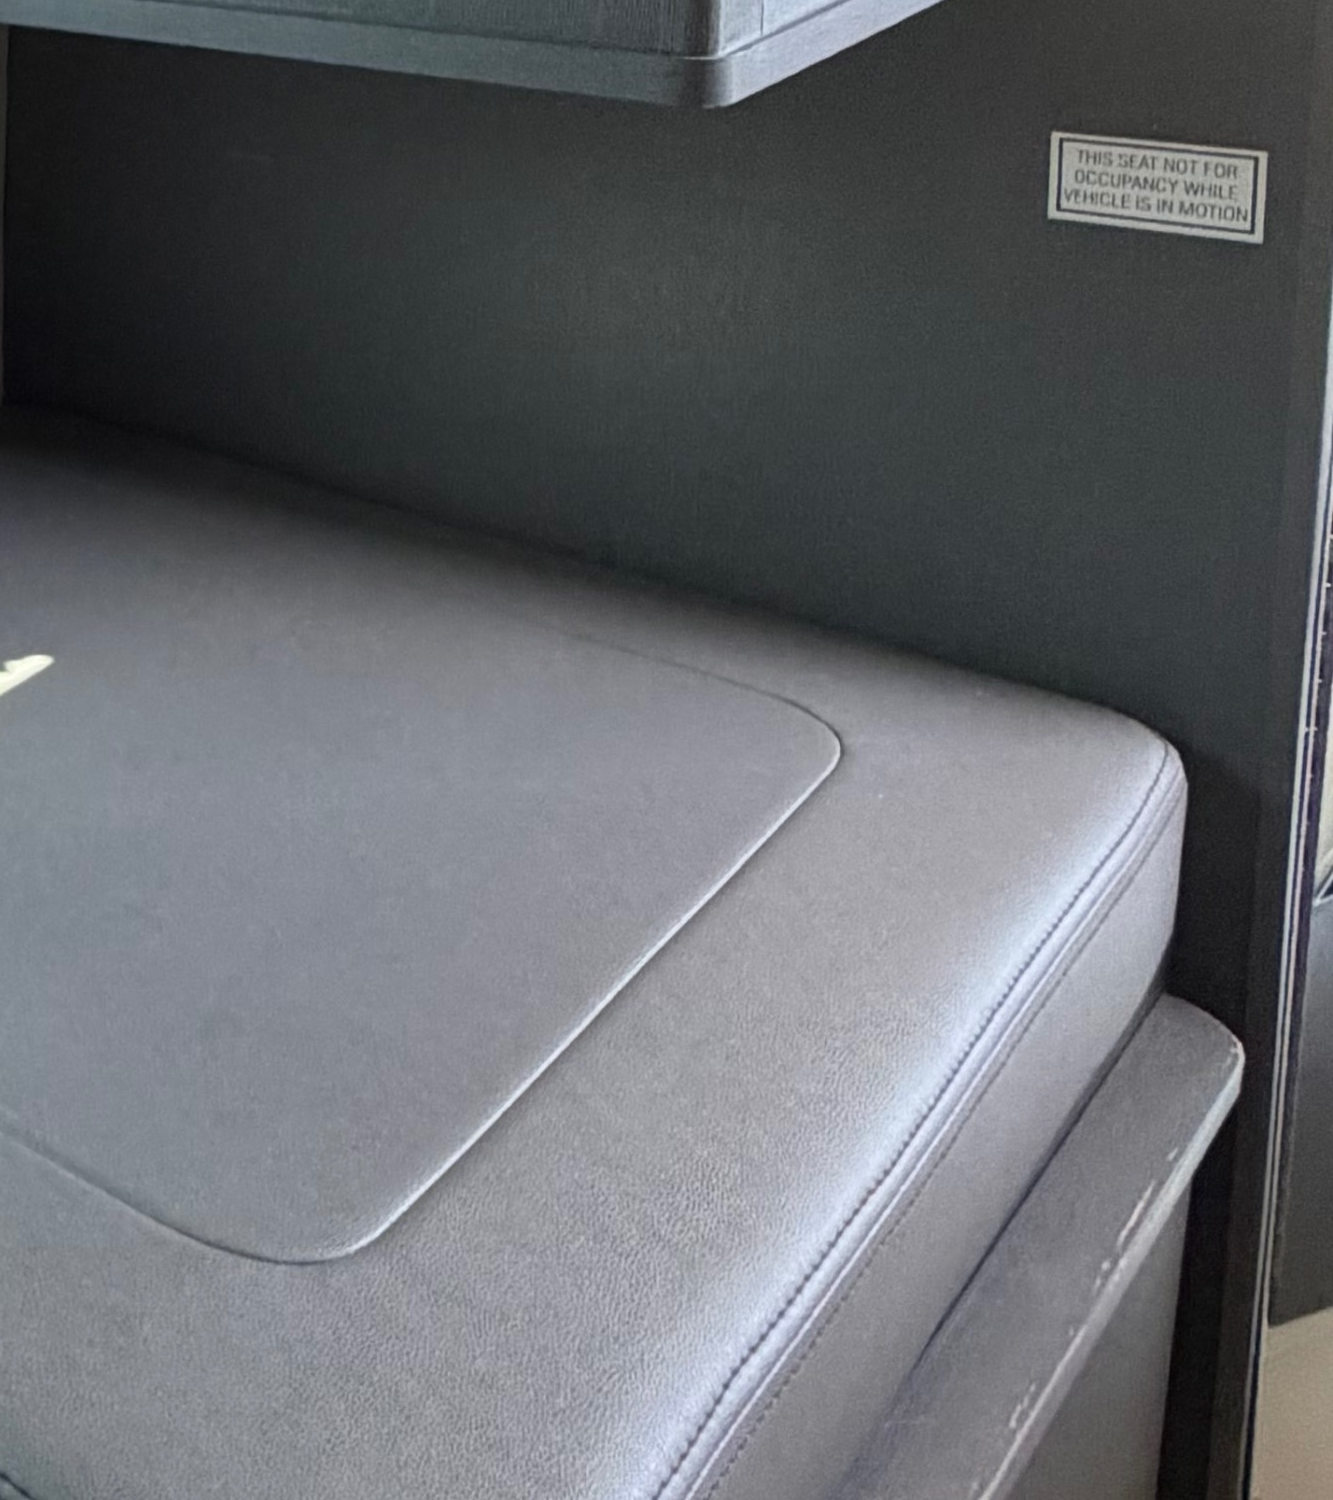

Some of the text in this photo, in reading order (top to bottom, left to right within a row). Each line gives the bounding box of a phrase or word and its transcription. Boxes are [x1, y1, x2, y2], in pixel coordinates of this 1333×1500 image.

[1077, 149, 1239, 180] THIS SEAT NOT FOR
[1074, 169, 1239, 201] OCCUPANCY WHILE
[1064, 188, 1248, 223] VEHICLE IS IN MOTION
